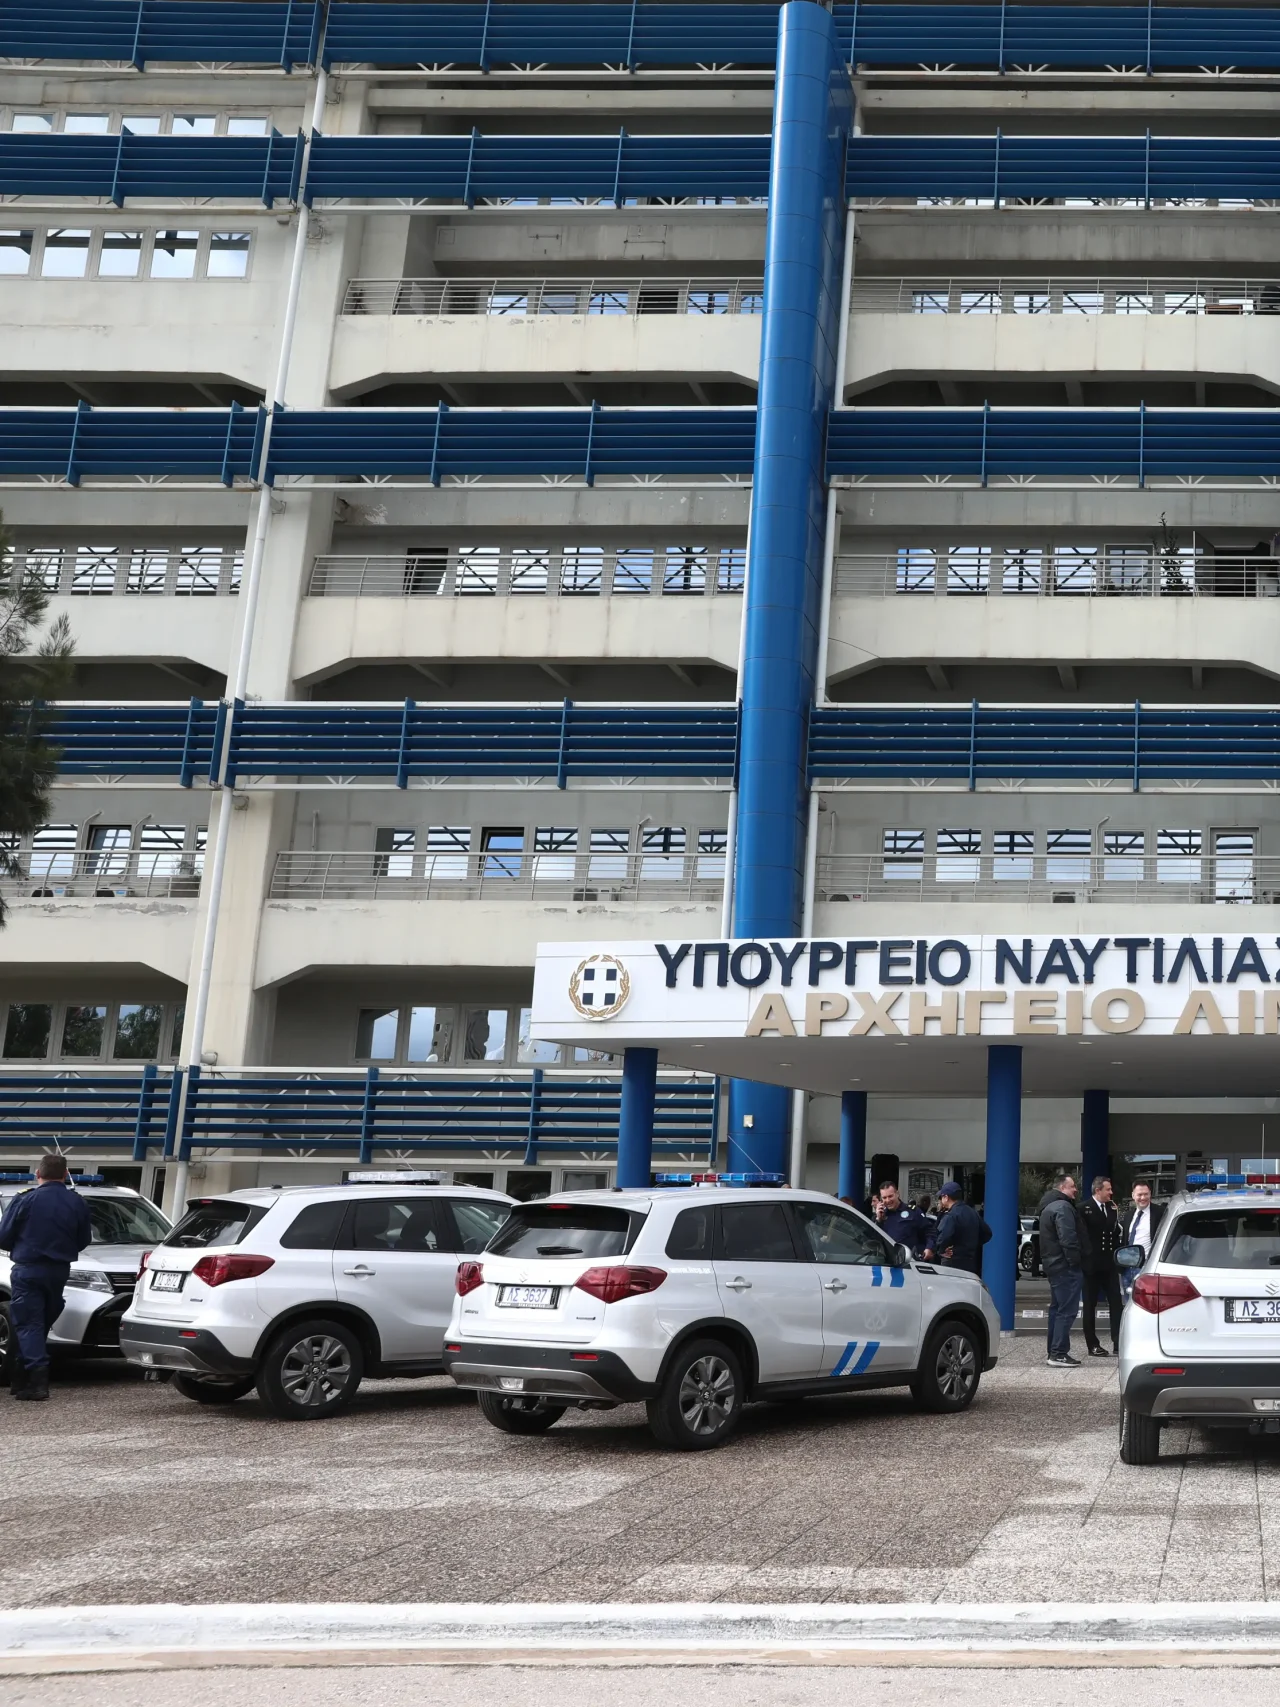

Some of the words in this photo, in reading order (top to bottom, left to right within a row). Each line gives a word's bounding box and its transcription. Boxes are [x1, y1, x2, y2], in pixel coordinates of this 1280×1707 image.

[655, 939, 971, 989] ΥΠΟΥΡΓΕΙΟ
[745, 990, 1147, 1037] ΑΡΧΗΓΕΙΟ
[507, 1288, 520, 1302] ΛΣ
[522, 1288, 548, 1303] 3637
[1242, 1301, 1260, 1316] ΛΣ
